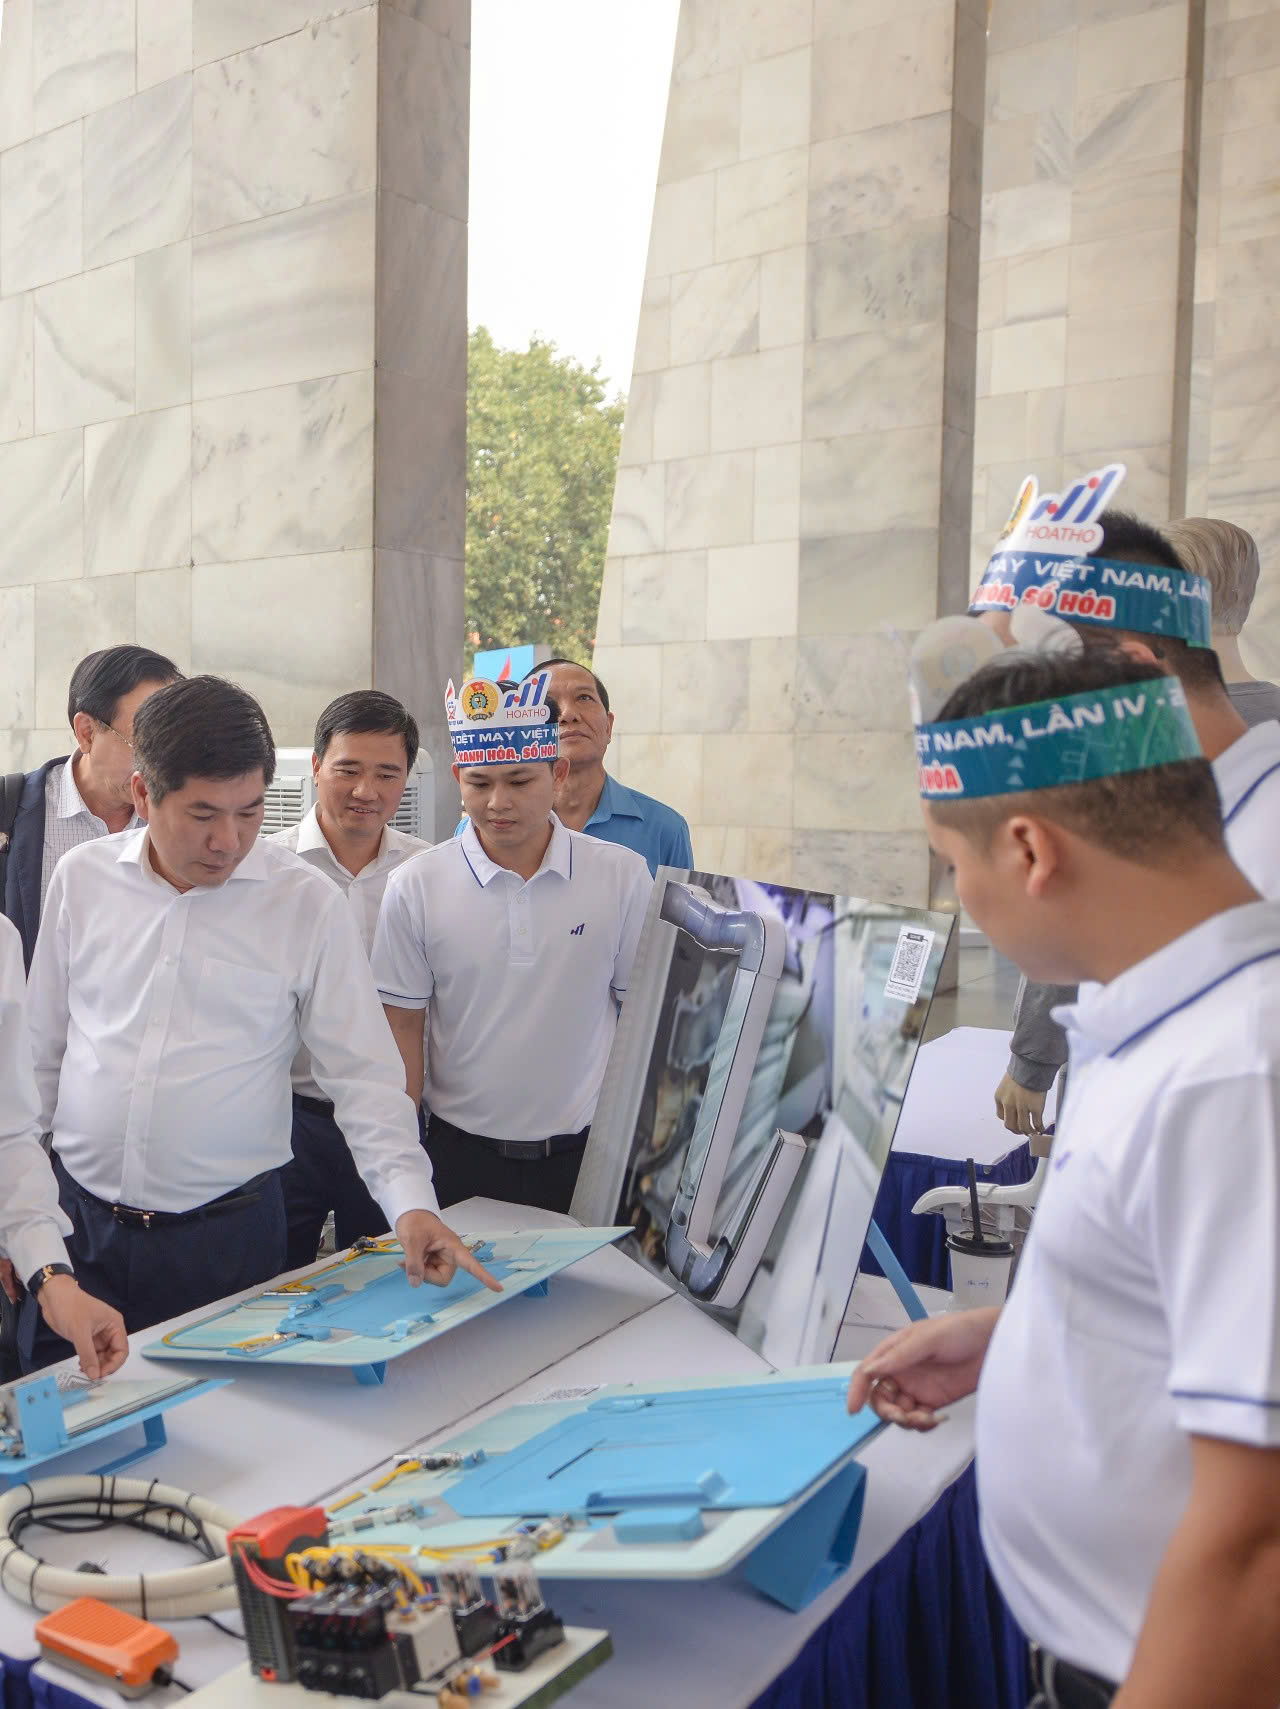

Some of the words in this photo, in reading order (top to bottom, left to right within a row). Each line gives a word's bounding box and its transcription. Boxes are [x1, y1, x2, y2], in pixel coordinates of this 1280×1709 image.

[1025, 524, 1096, 544] HOATHO
[1034, 559, 1095, 583] VIỆT
[1101, 567, 1173, 595] NAM,
[1023, 582, 1061, 609] SỐ
[1057, 589, 1116, 620] HÓA
[506, 708, 547, 719] HOATHO
[934, 723, 1015, 752] NAM,
[1021, 704, 1106, 738] LẦN
[1112, 694, 1146, 719] IV
[456, 733, 475, 746] DỆT
[479, 731, 516, 742] MAY
[521, 728, 550, 741] VIỆT
[486, 746, 521, 762] HÓA,
[522, 741, 539, 760] SỐ
